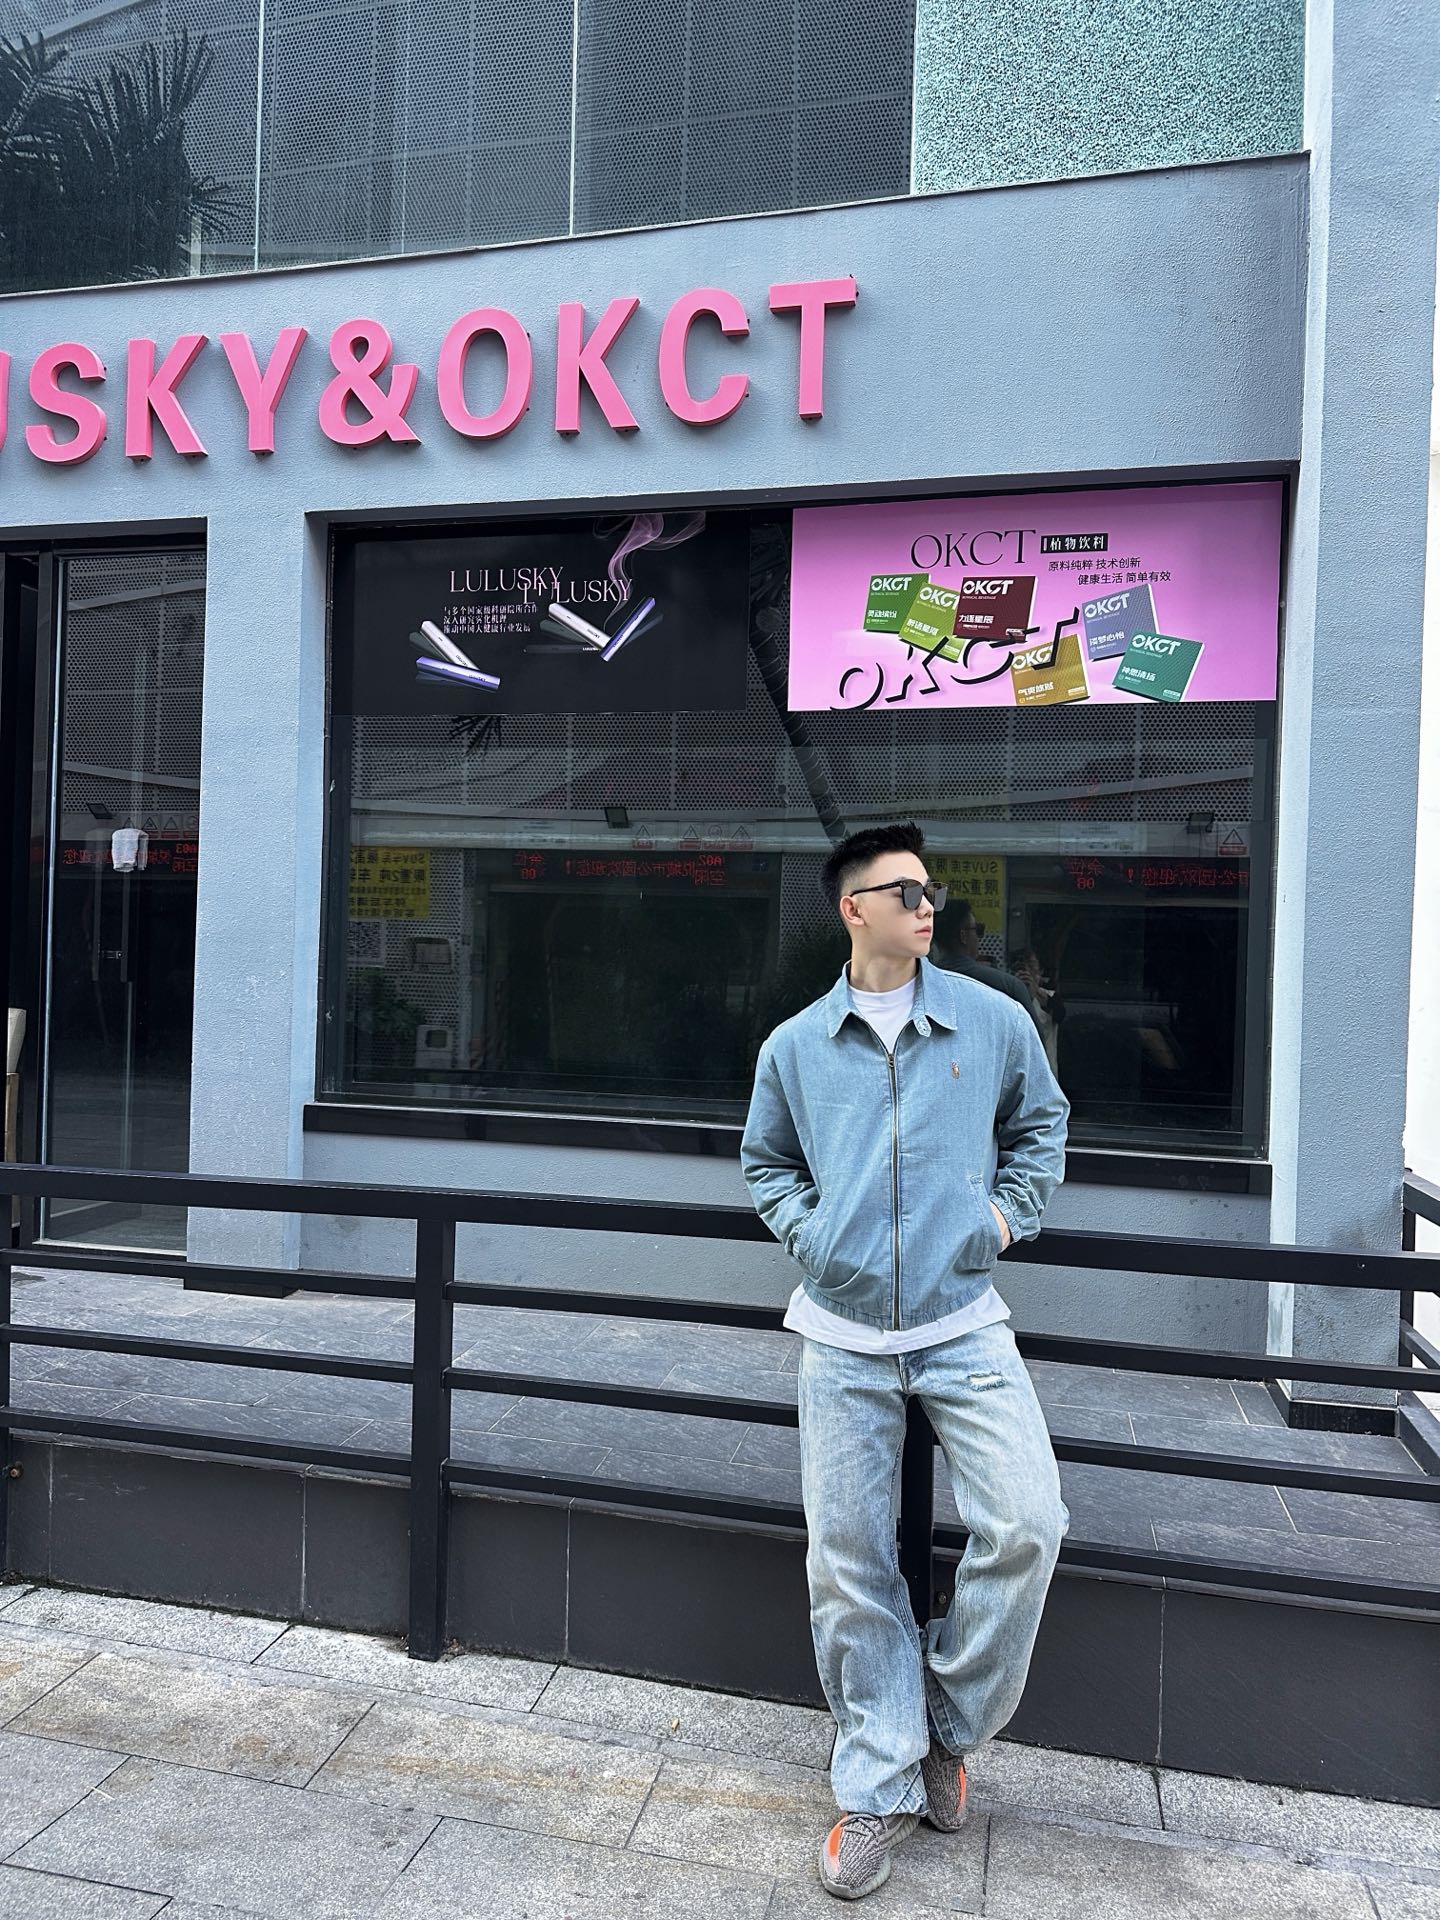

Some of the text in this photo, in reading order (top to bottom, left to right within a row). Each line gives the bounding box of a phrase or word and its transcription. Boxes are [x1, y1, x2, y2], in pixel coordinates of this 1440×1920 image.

[0, 277, 858, 466] SKY&OKCT
[911, 529, 1036, 569] OKCT
[1050, 536, 1105, 551] 植物饮料
[1048, 557, 1140, 572] 原料纯粹 技术创新
[871, 576, 913, 592] OKCT
[1078, 571, 1171, 586] 健康生活 简单有效
[962, 579, 1014, 595] OKCT
[1083, 592, 1130, 619] OKCT
[1131, 633, 1182, 656] OKCT
